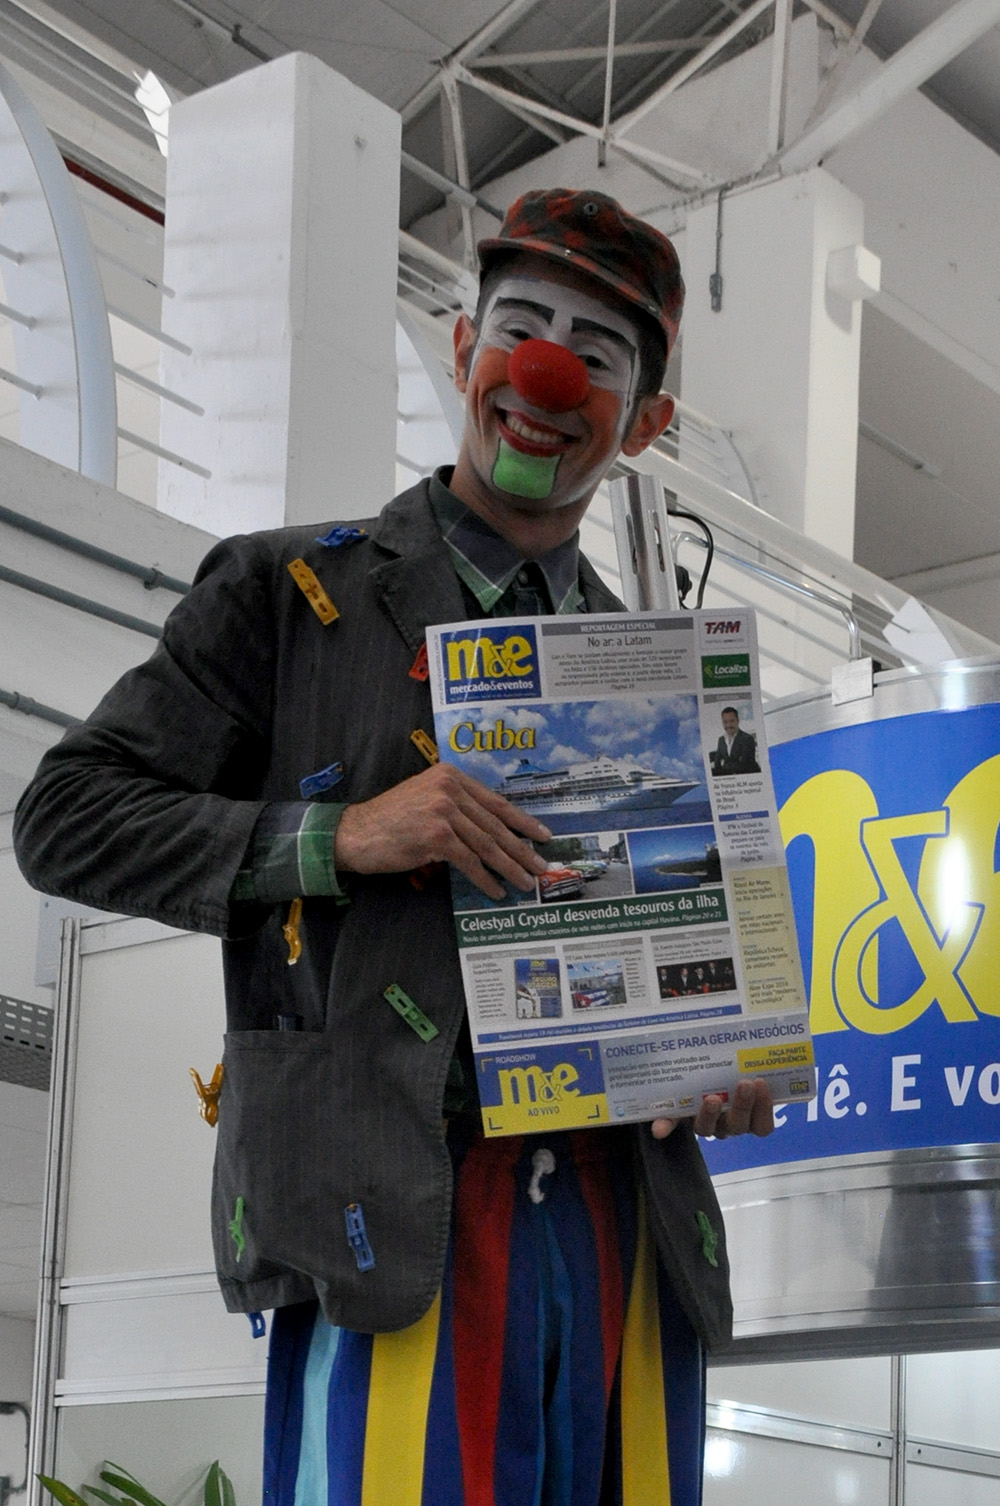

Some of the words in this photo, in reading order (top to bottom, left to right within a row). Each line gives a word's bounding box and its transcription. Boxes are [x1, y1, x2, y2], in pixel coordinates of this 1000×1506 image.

[580, 623, 625, 633] REPORTAGEM
[626, 621, 655, 630] ESPECIAL
[704, 621, 741, 634] TAM
[586, 636, 600, 647] No
[623, 634, 652, 645] Latam
[446, 636, 533, 681] m&e
[714, 664, 748, 674] Localiza
[450, 680, 534, 694] mercado&eventos
[449, 720, 535, 753] Cuba
[460, 913, 515, 935] Celestyal
[517, 909, 560, 929] Crystal
[562, 903, 620, 922] desvenda
[622, 898, 675, 916] tesouros
[677, 896, 693, 910] da
[695, 893, 719, 908] ilha
[605, 1039, 676, 1058] CONECTE-SE
[677, 1035, 707, 1049] PARA
[708, 1030, 748, 1046] GERAR
[748, 1019, 804, 1041] NEGÓCIOS
[768, 1048, 786, 1058] FAÇA
[786, 1045, 806, 1055] PARTE
[496, 1054, 536, 1064] ROADSHOW
[650, 1059, 672, 1068] evento
[672, 1055, 697, 1065] voltado
[705, 1059, 733, 1068] conectar
[744, 1058, 765, 1068] DESSA
[765, 1052, 807, 1065] EXPERIÊNCIA
[498, 1063, 580, 1105] m&e
[890, 1054, 922, 1112] E
[528, 1108, 539, 1117] AO
[541, 1106, 560, 1116] VIVO
